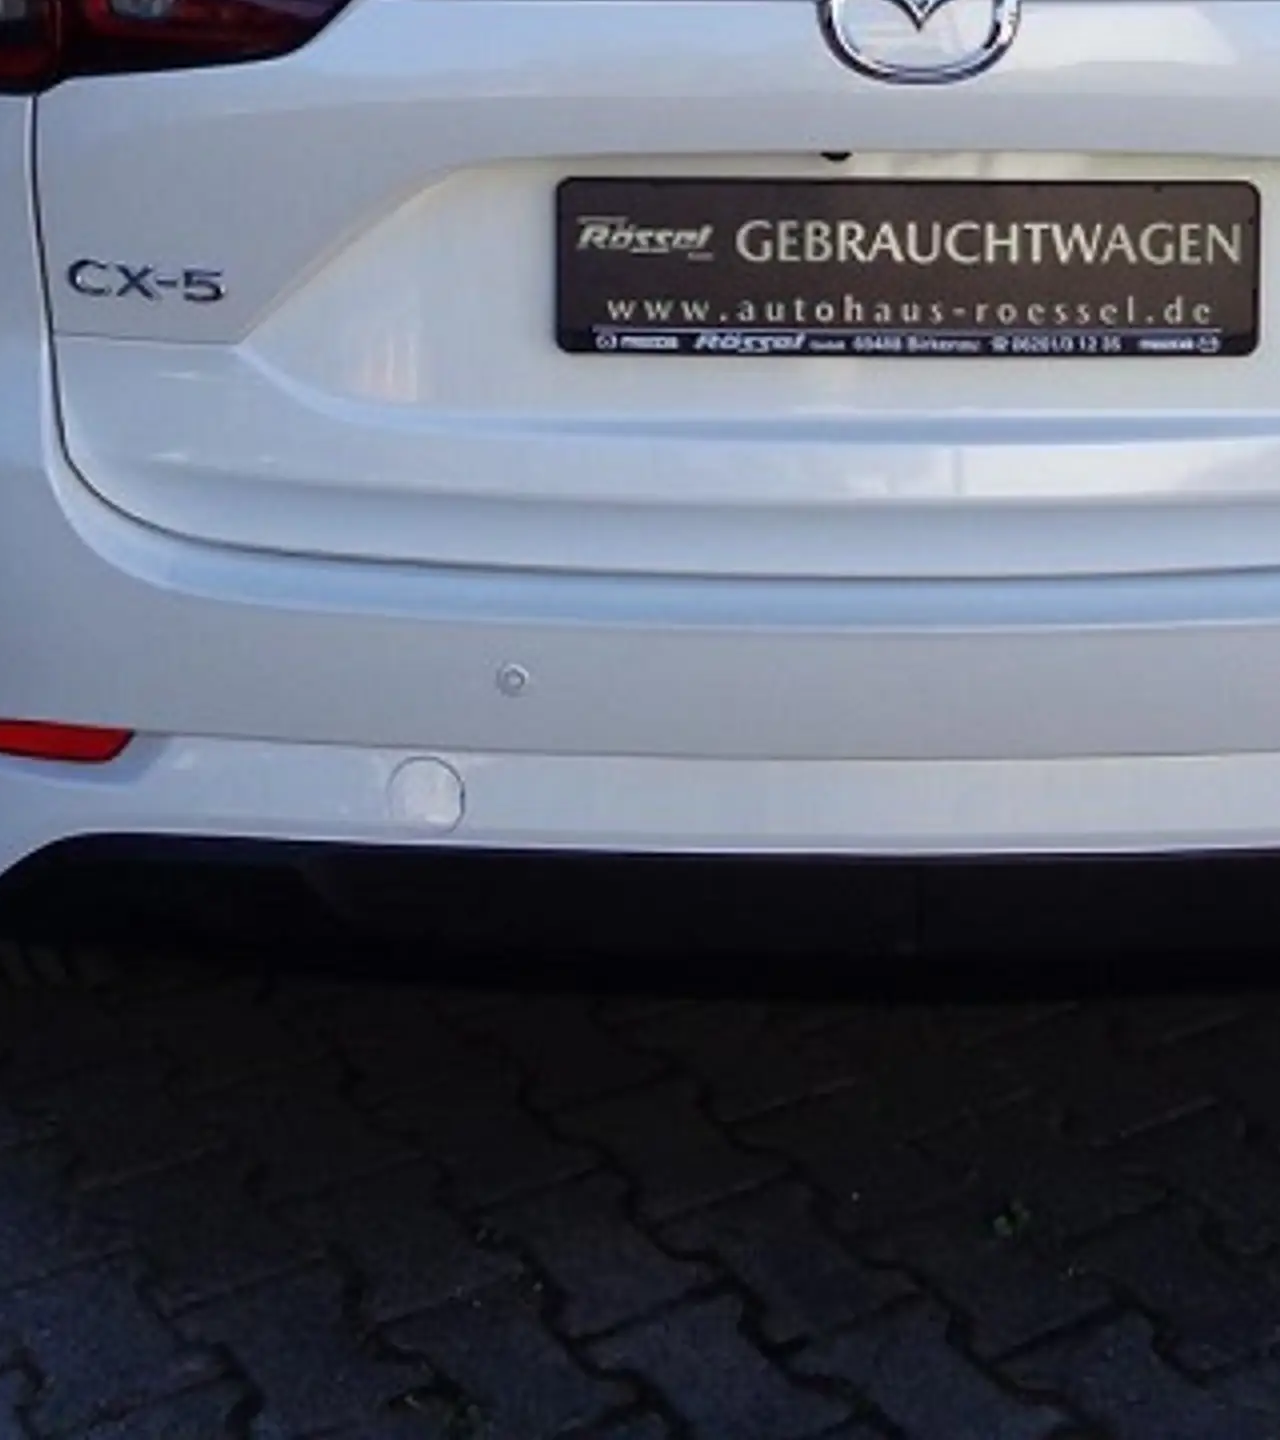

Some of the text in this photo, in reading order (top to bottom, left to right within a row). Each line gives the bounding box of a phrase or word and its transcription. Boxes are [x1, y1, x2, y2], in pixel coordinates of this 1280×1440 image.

[577, 219, 1242, 266] Rössel GEBRAUCHTWAGEN
[67, 258, 227, 303] CX-5
[606, 293, 1212, 326] www.autohaus-roessel.de
